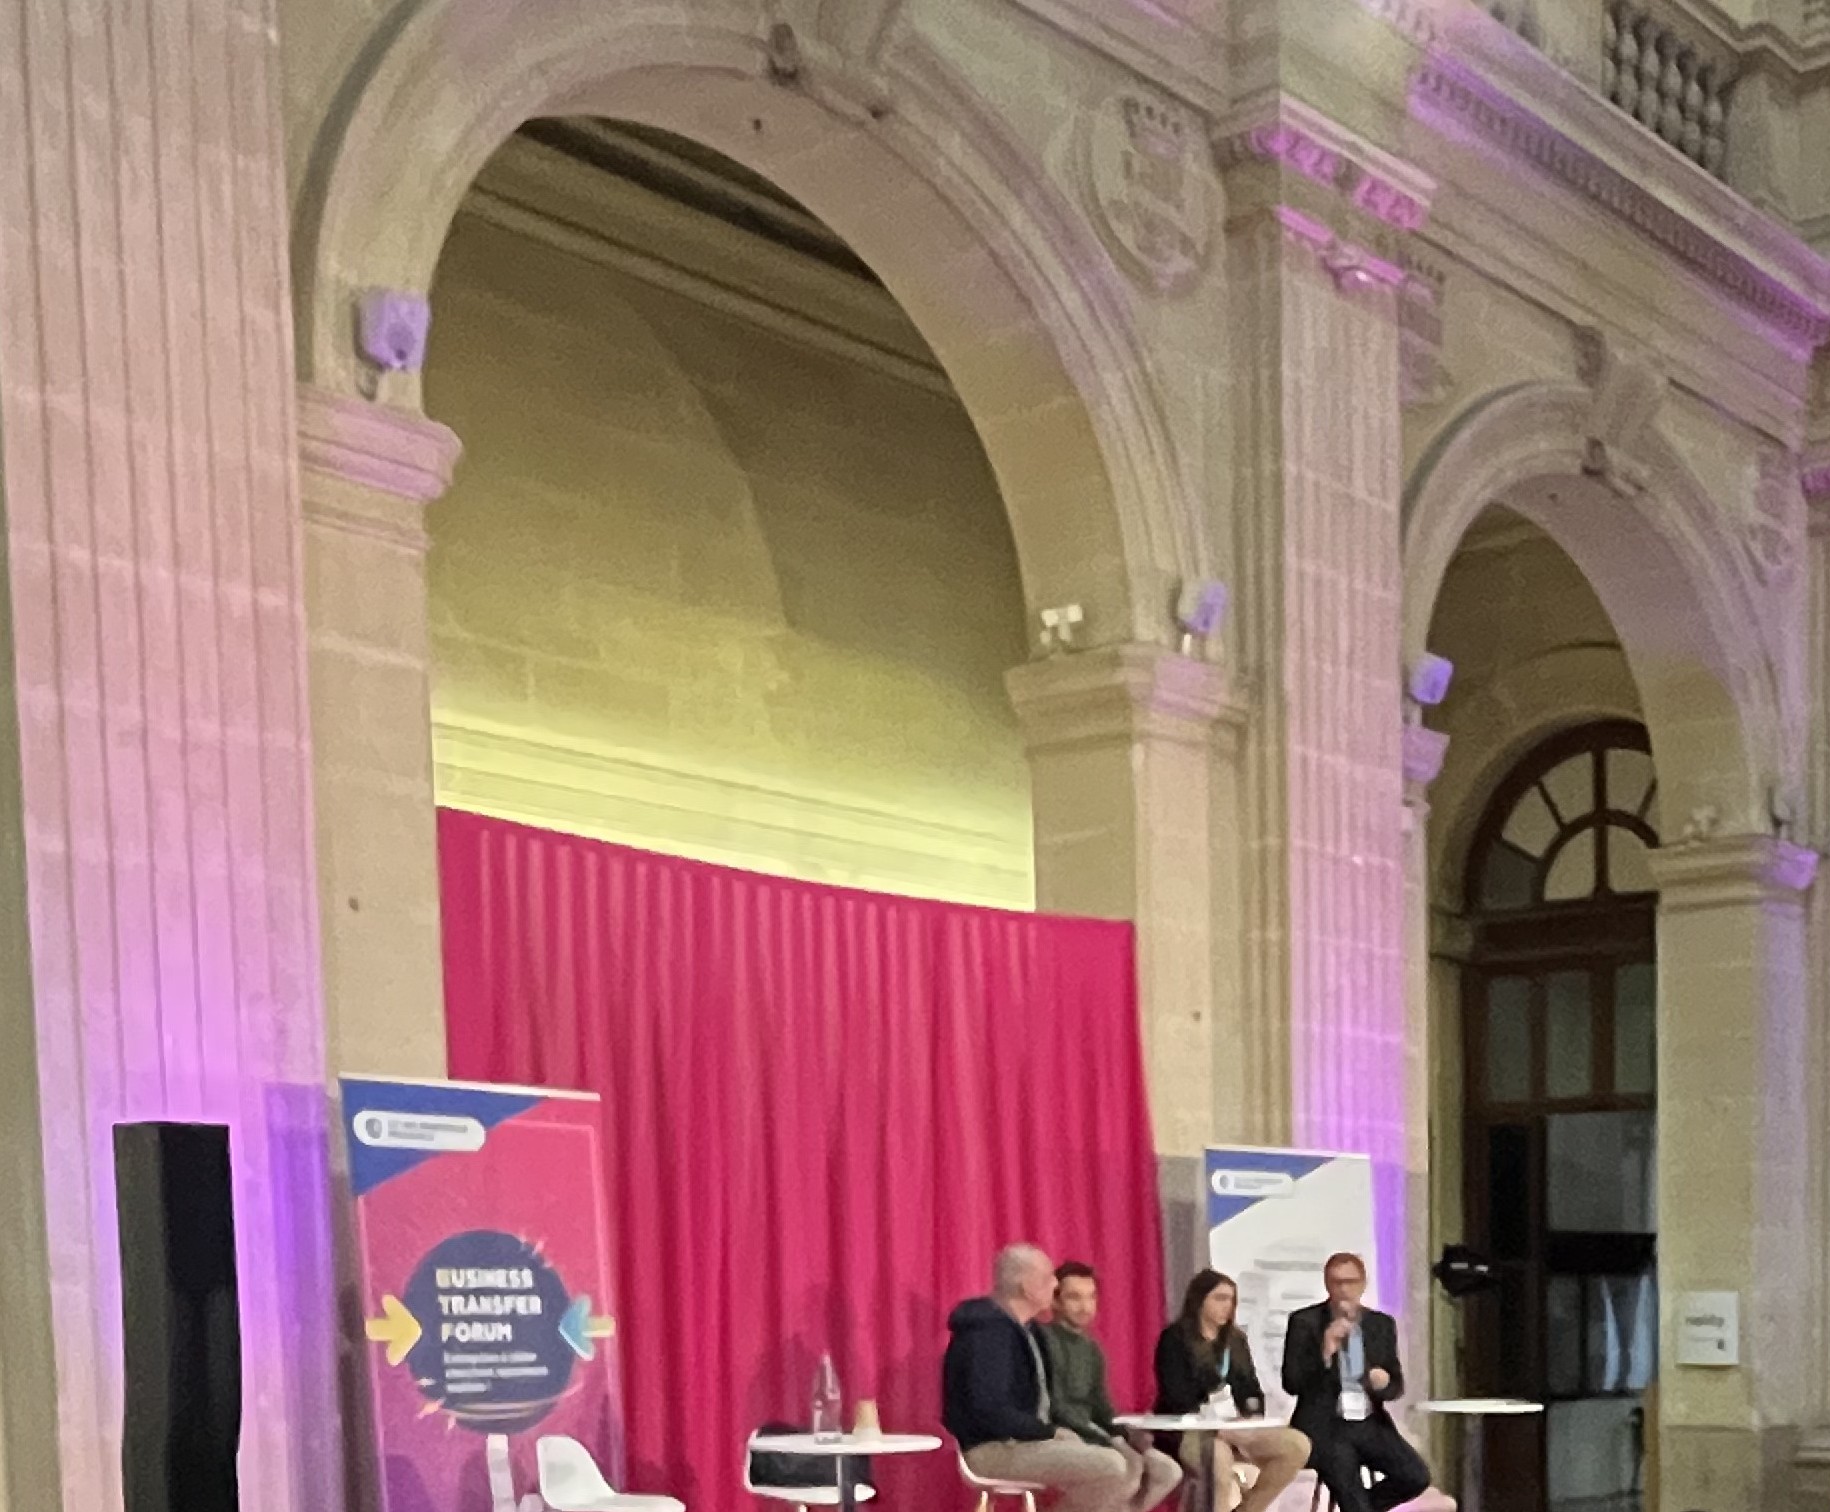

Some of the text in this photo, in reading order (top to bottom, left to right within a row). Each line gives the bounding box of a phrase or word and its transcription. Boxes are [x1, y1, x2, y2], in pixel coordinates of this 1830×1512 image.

[436, 1268, 533, 1288] BUSINESS
[438, 1294, 542, 1315] TRANSFER
[441, 1322, 512, 1342] FORUM
